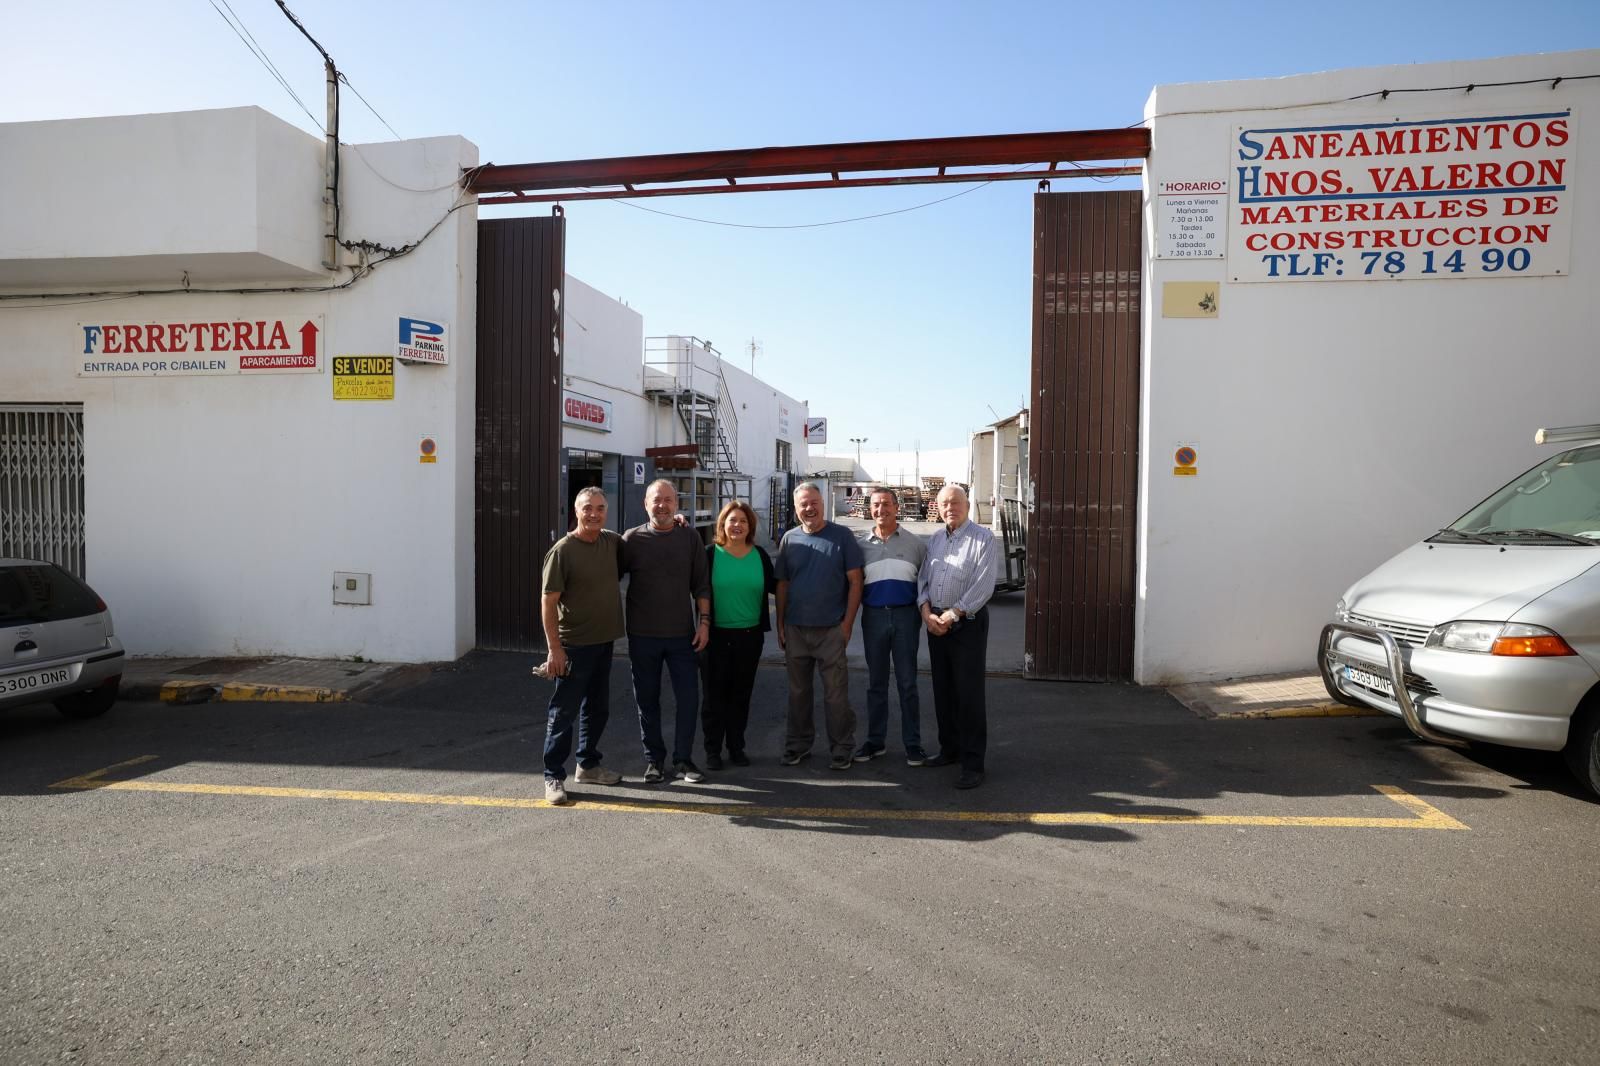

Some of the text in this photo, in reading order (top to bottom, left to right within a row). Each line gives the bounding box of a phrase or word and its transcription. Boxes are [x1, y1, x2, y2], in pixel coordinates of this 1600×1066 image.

[1238, 120, 1569, 160] SANEAMIENTOS
[1166, 181, 1221, 191] HORARIO
[1237, 159, 1566, 198] HNOS. VALERON
[1240, 196, 1558, 225] MATERIALES DE
[1246, 224, 1551, 251] CONSTRUCCION
[1262, 248, 1531, 276] TLF: 78 14 90
[83, 320, 291, 354] FERRETERIA
[399, 316, 444, 345] P
[399, 346, 445, 361] FERRETERIA
[415, 340, 445, 352] PARKING
[84, 360, 226, 372] ENTRADA POR C/BAILEN
[241, 355, 315, 367] APARCAMIENTOS
[335, 358, 393, 374] SE VENDE
[41, 670, 68, 685] DNR
